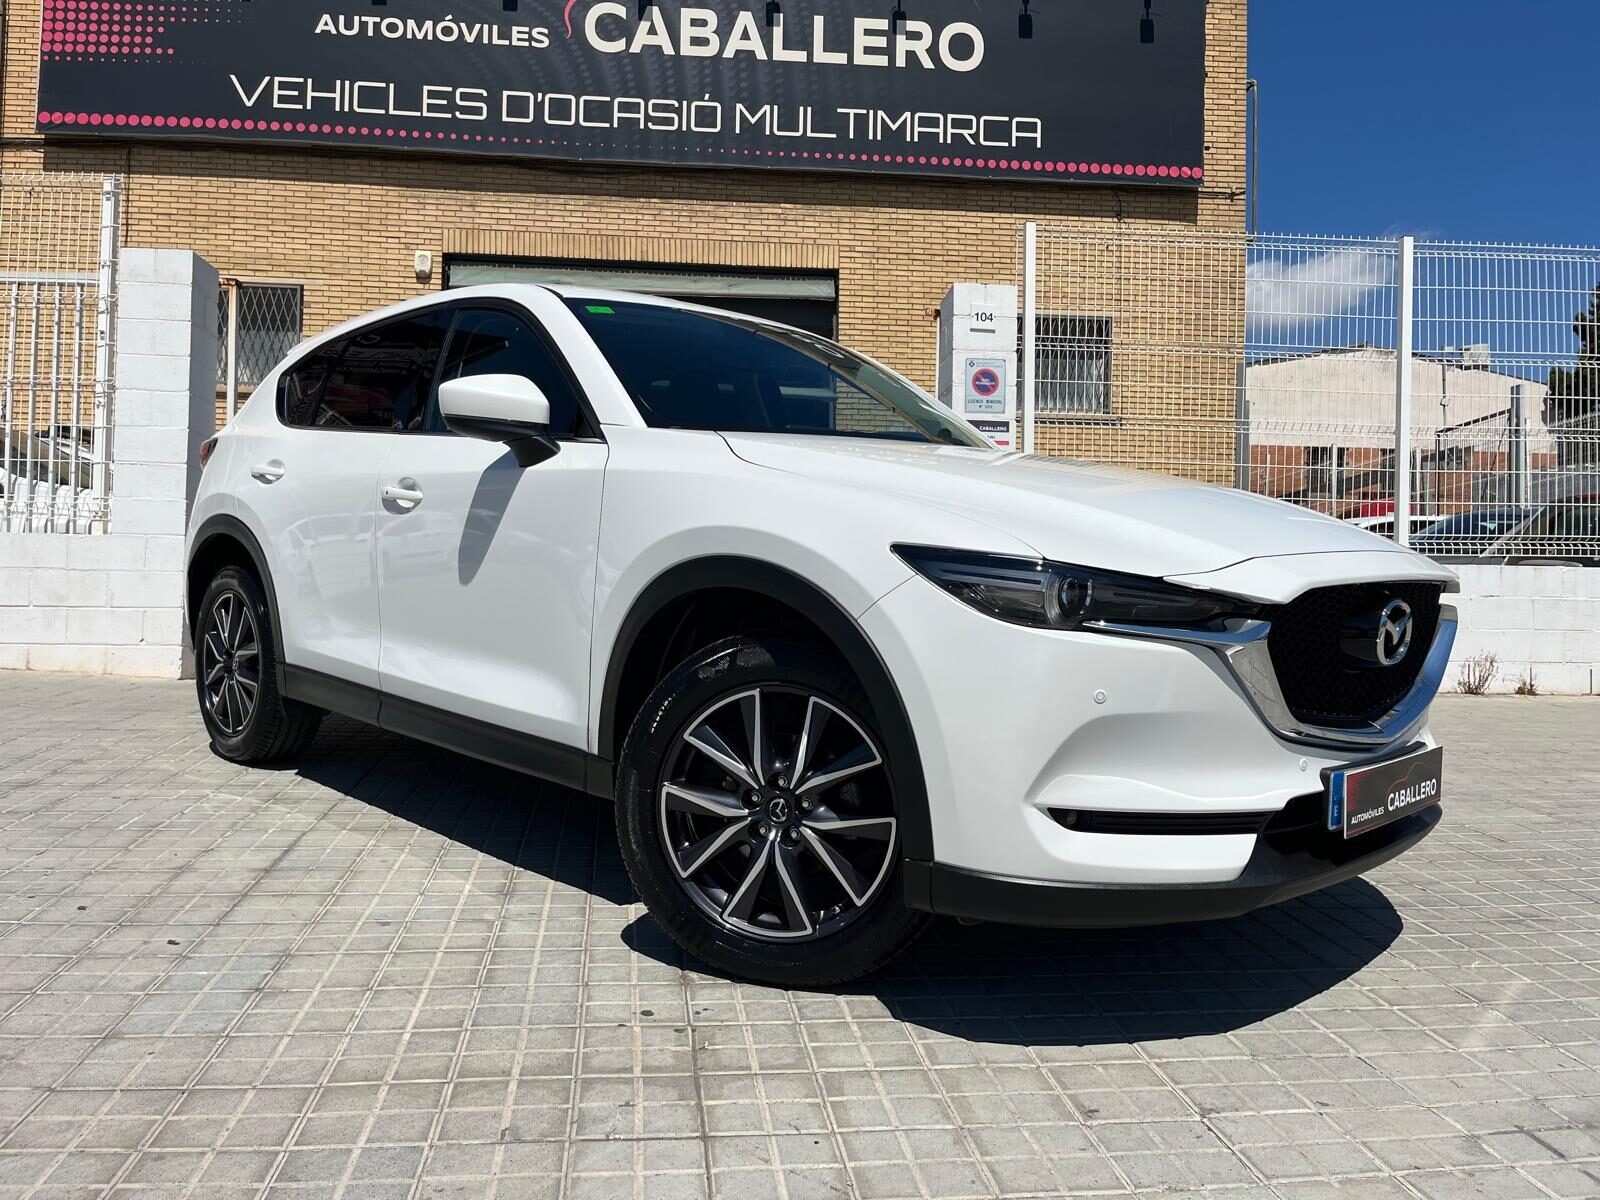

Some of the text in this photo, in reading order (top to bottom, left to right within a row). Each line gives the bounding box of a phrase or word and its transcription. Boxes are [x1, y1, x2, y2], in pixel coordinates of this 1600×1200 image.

[314, 1, 985, 72] AUTOMÓVILES CABALLERO
[229, 74, 488, 121] VEHICLES
[501, 90, 722, 134] D'OCASIÓ
[974, 312, 994, 323] 104
[1351, 779, 1437, 824] AUTOMÓVILES CABALLERO
